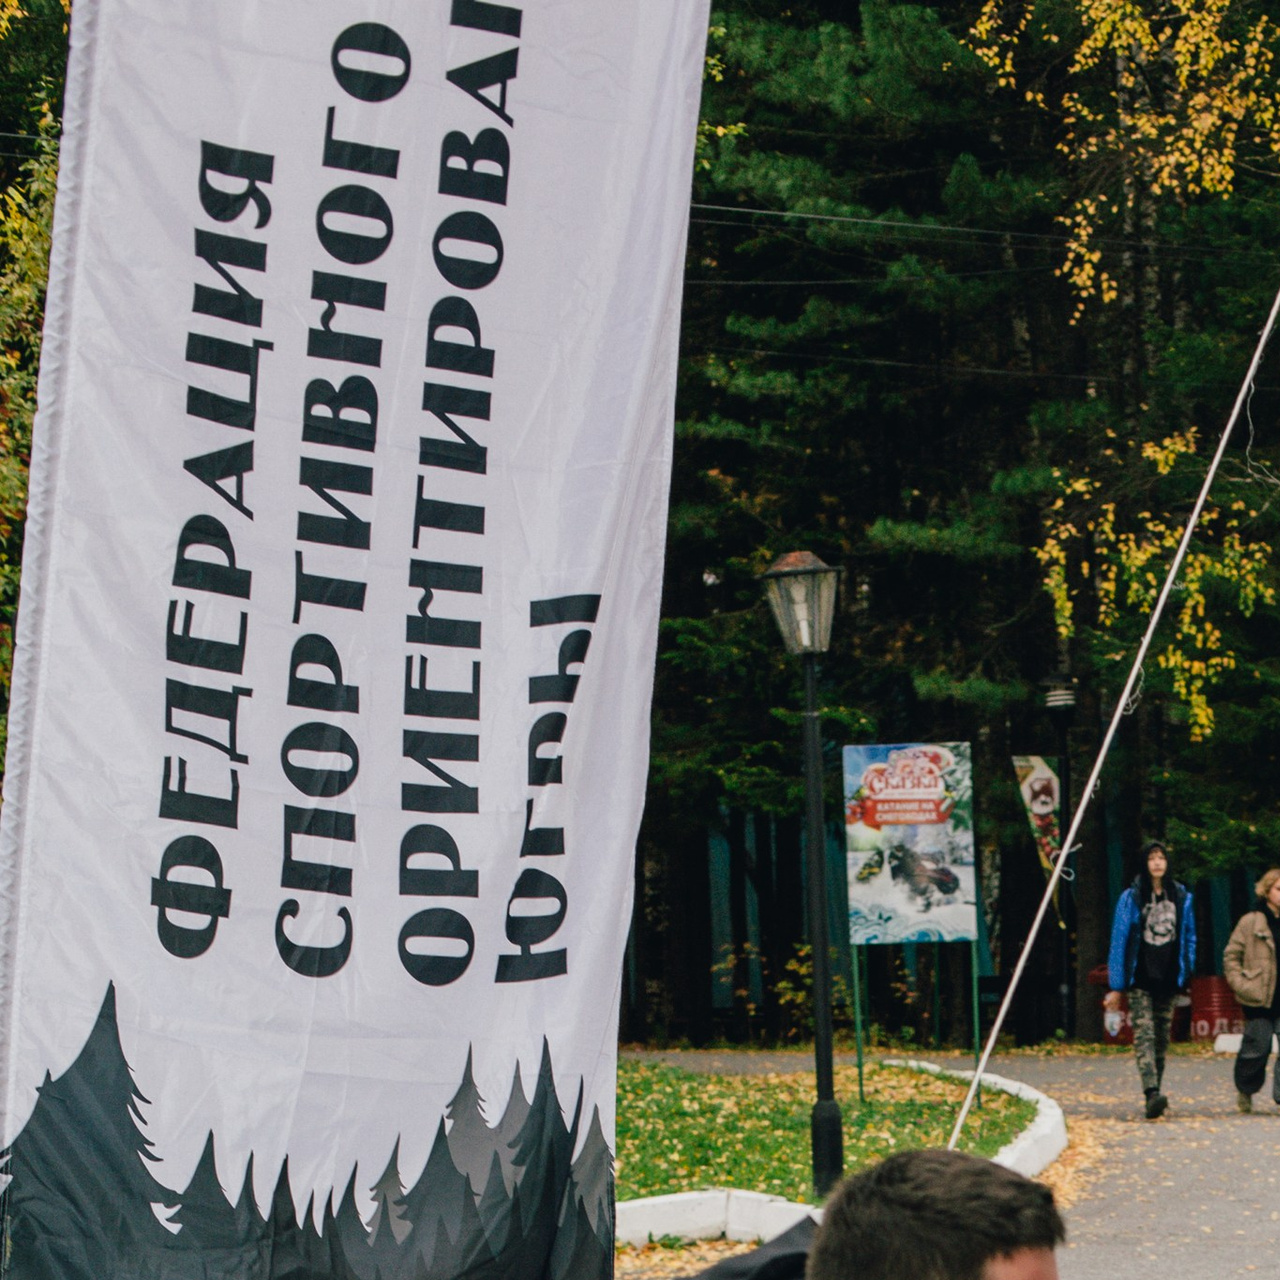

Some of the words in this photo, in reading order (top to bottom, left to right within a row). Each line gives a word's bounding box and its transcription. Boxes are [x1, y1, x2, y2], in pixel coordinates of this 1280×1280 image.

[150, 140, 275, 959] ФЕДЕРАЦИЯ
[275, 22, 412, 978] СПОРТИВНОГО
[494, 594, 602, 983] ЮГРЫ
